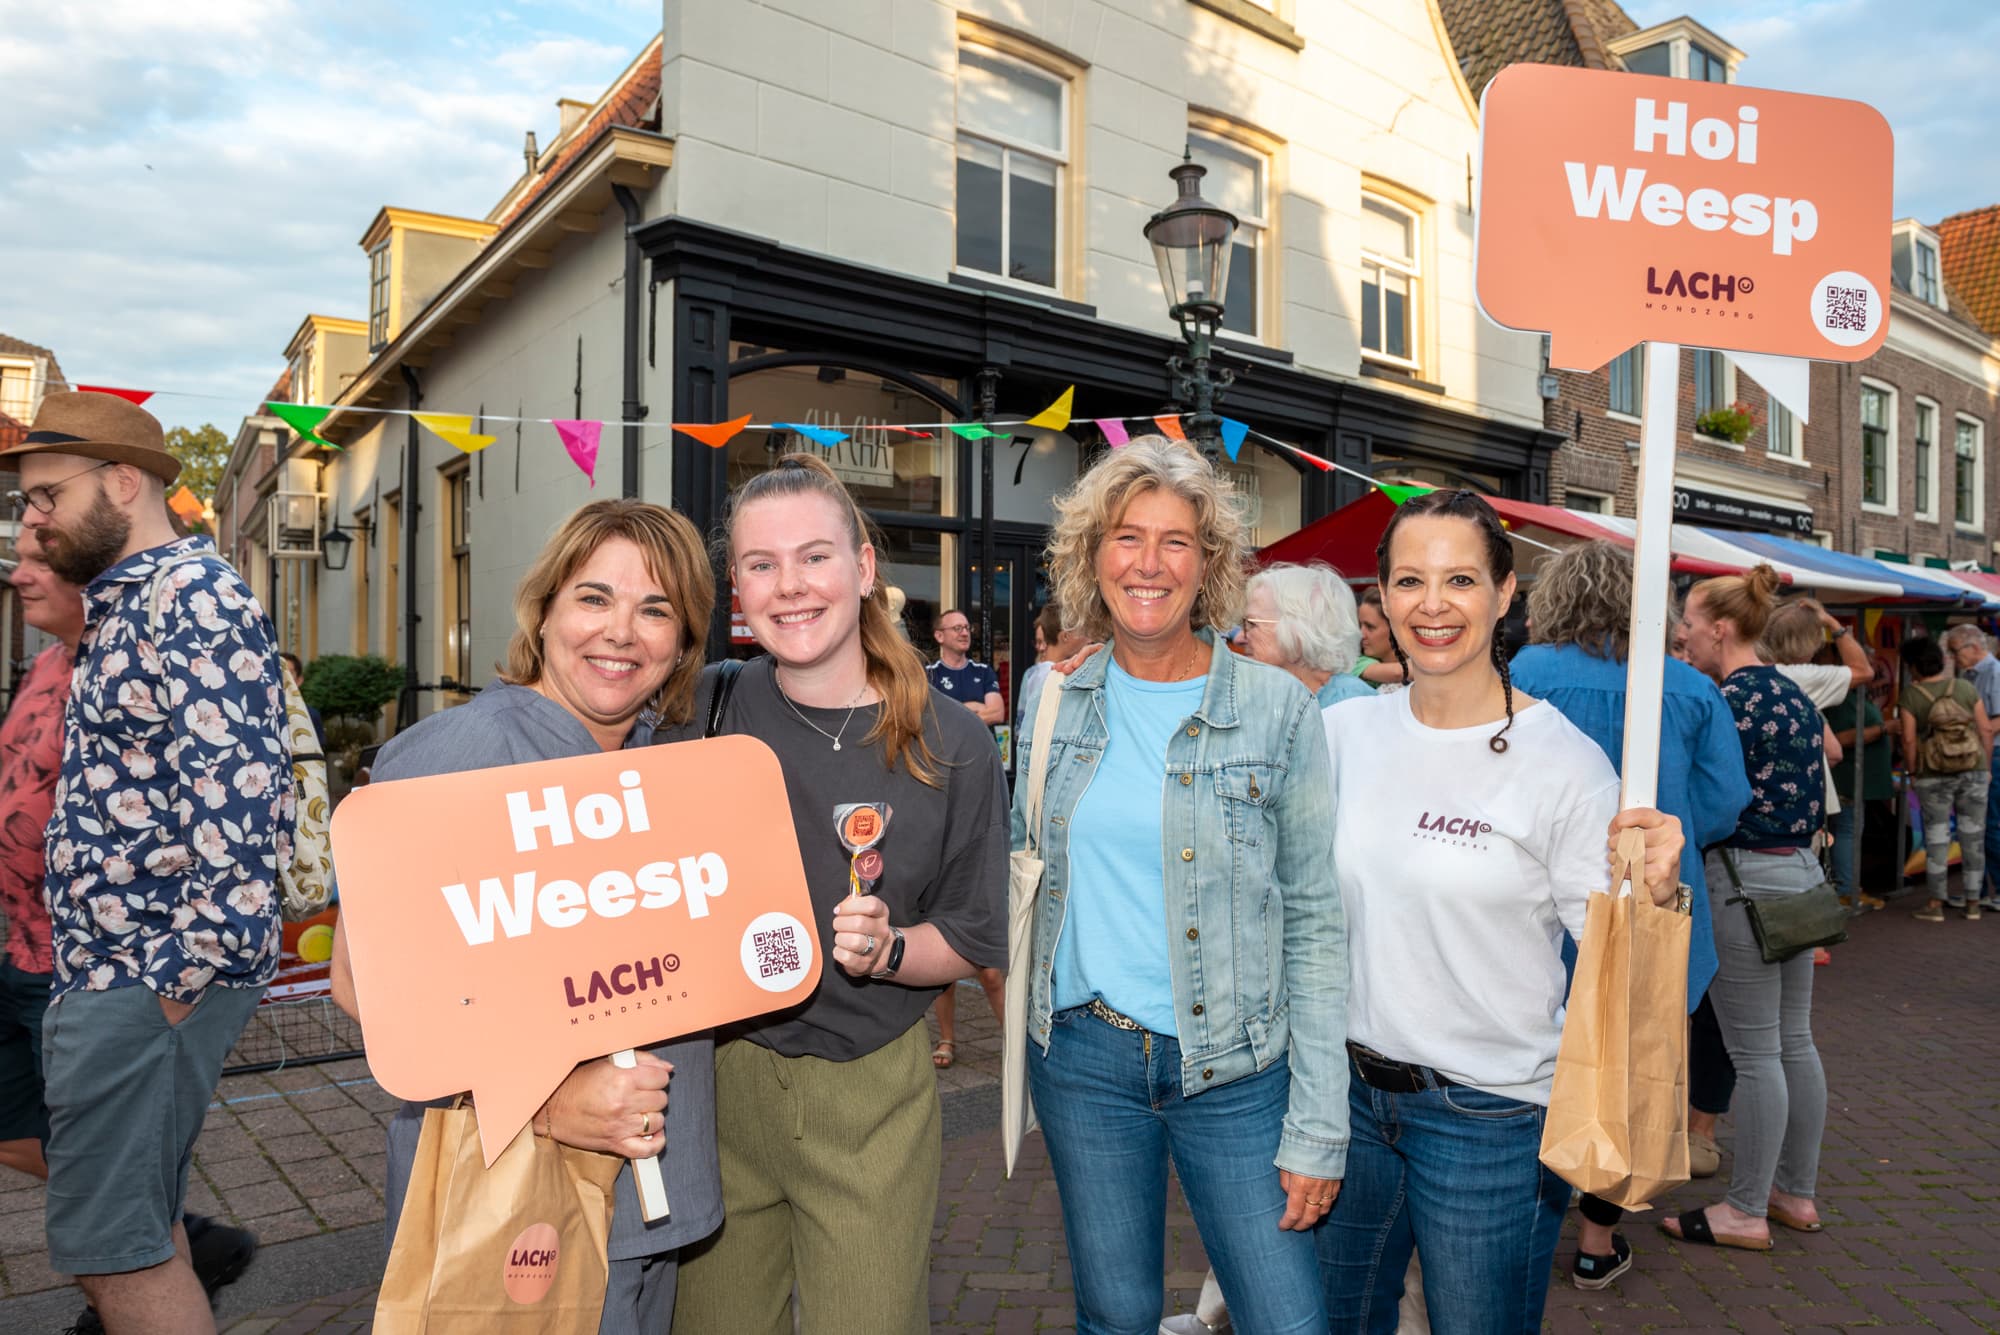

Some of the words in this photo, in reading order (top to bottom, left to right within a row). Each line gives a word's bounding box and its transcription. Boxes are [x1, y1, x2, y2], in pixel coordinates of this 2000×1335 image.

[1634, 98, 1759, 164] Hoi
[1564, 161, 1819, 256] Weesp
[851, 415, 889, 470] CHA
[1010, 435, 1035, 487] 7
[505, 769, 651, 853] Hoi
[440, 851, 729, 947] Weesp
[570, 991, 688, 1026] MONDZORG
